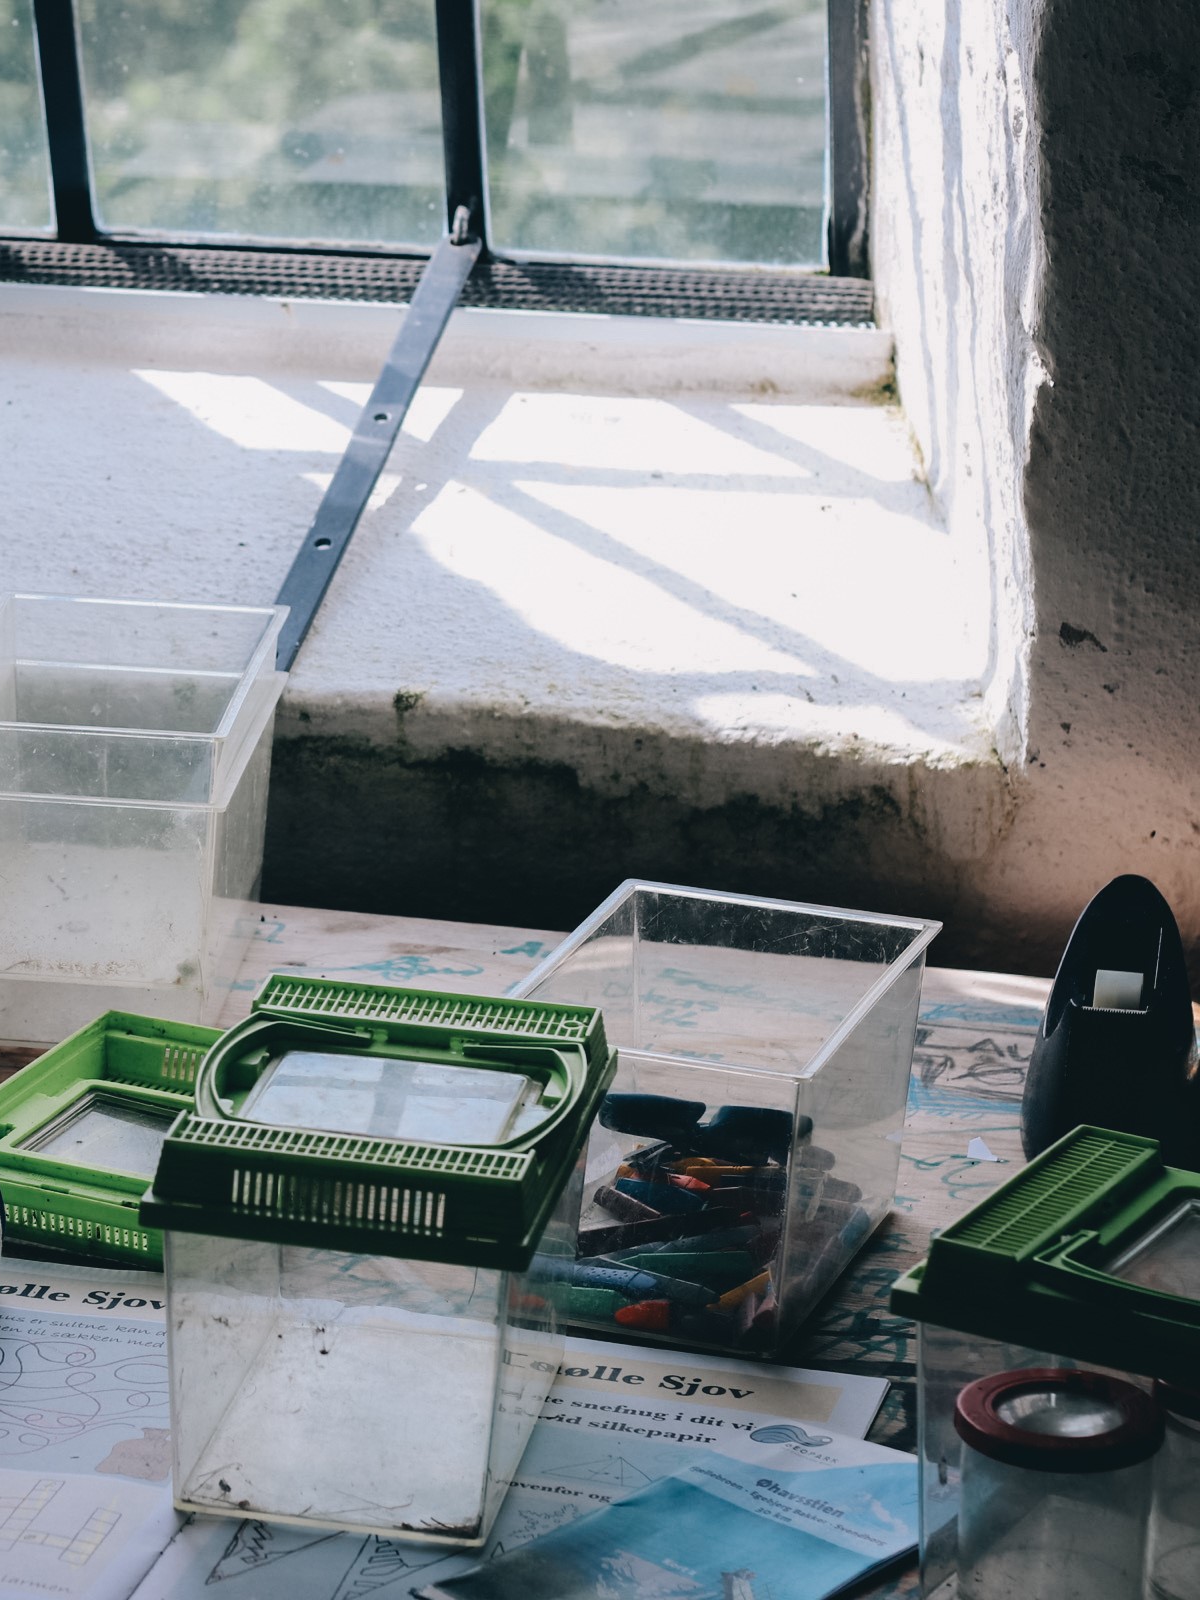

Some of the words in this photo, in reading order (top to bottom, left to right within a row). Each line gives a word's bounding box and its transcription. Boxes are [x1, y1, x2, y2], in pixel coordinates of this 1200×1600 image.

[27, 1327, 47, 1337] til
[115, 1324, 151, 1336] kan
[657, 1373, 756, 1401] Sjov
[569, 1397, 670, 1422] snefnug
[689, 1414, 726, 1429] dit
[586, 1419, 719, 1445] silkepapir
[587, 1492, 614, 1504] og
[755, 1477, 847, 1519] Øhavsstien
